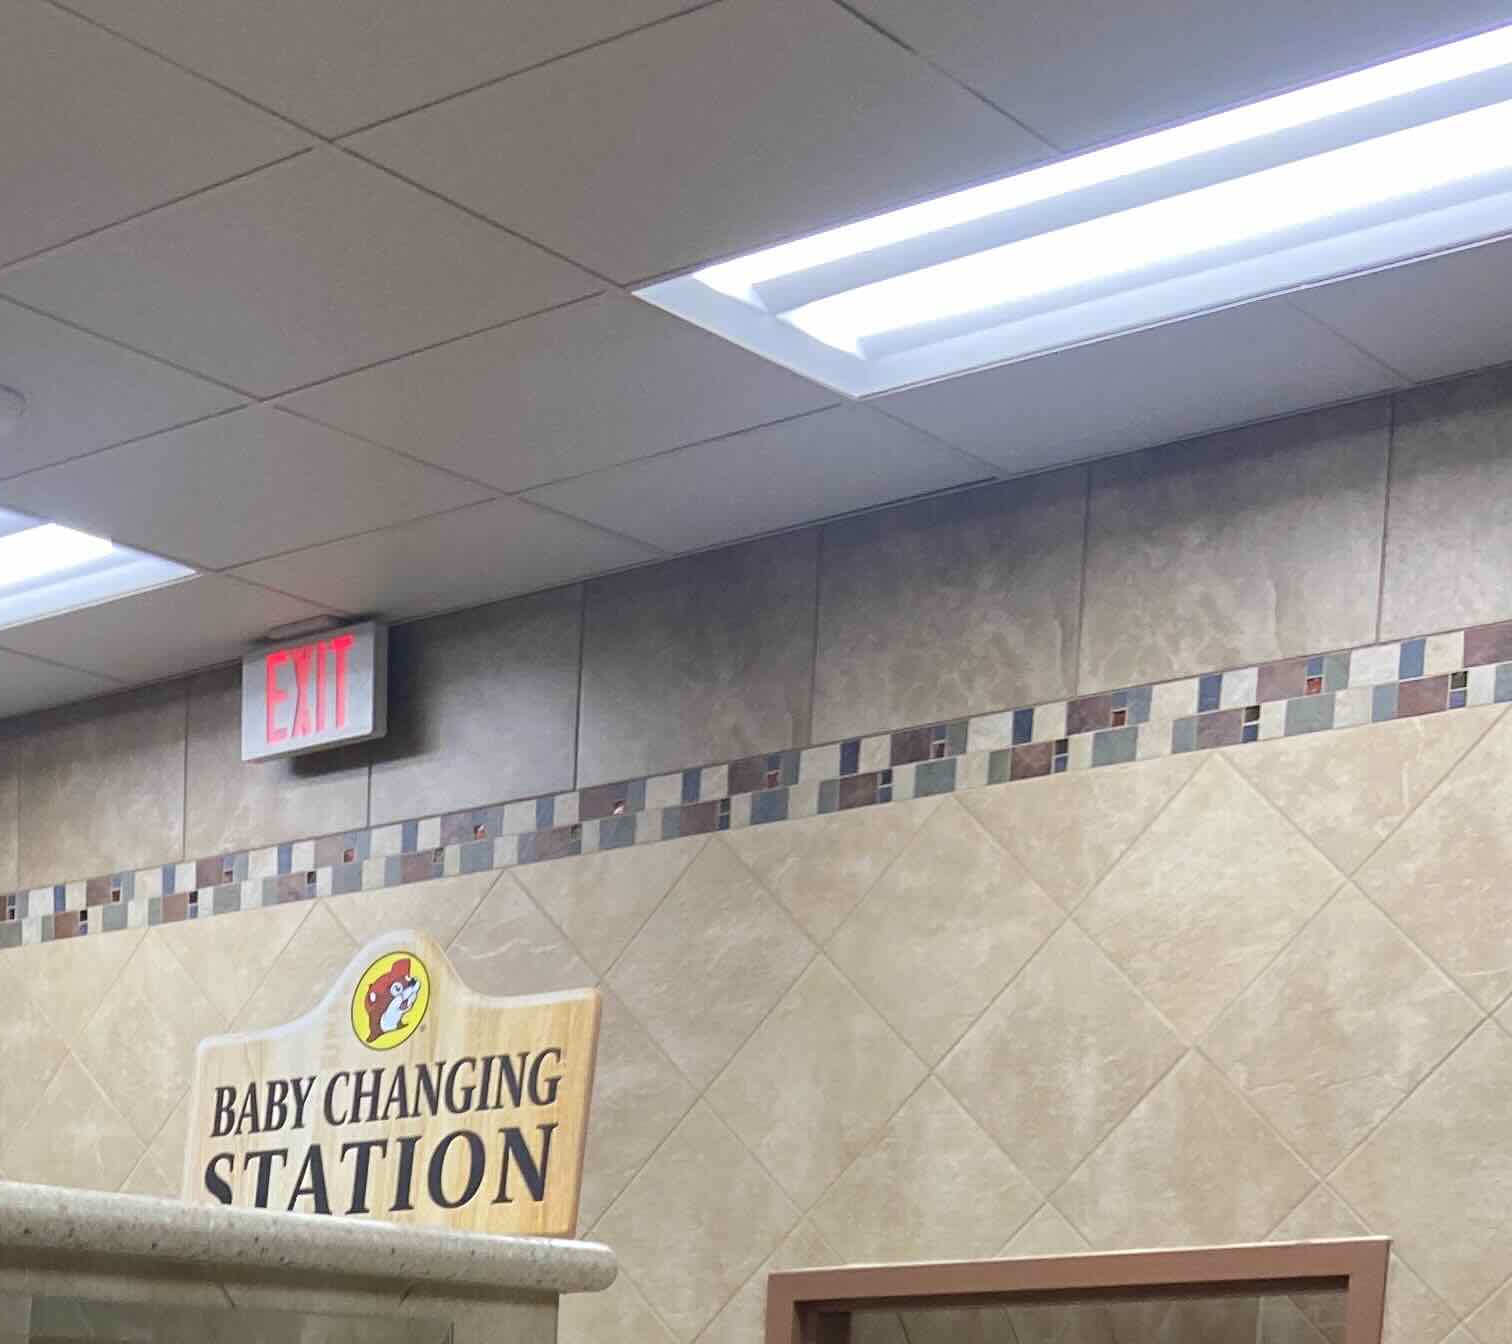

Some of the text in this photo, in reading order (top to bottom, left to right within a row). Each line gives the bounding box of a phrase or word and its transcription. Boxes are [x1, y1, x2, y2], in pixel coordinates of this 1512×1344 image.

[265, 634, 355, 745] EXIT
[210, 1047, 563, 1139] BABY CHANGING
[203, 1122, 559, 1217] STATION
